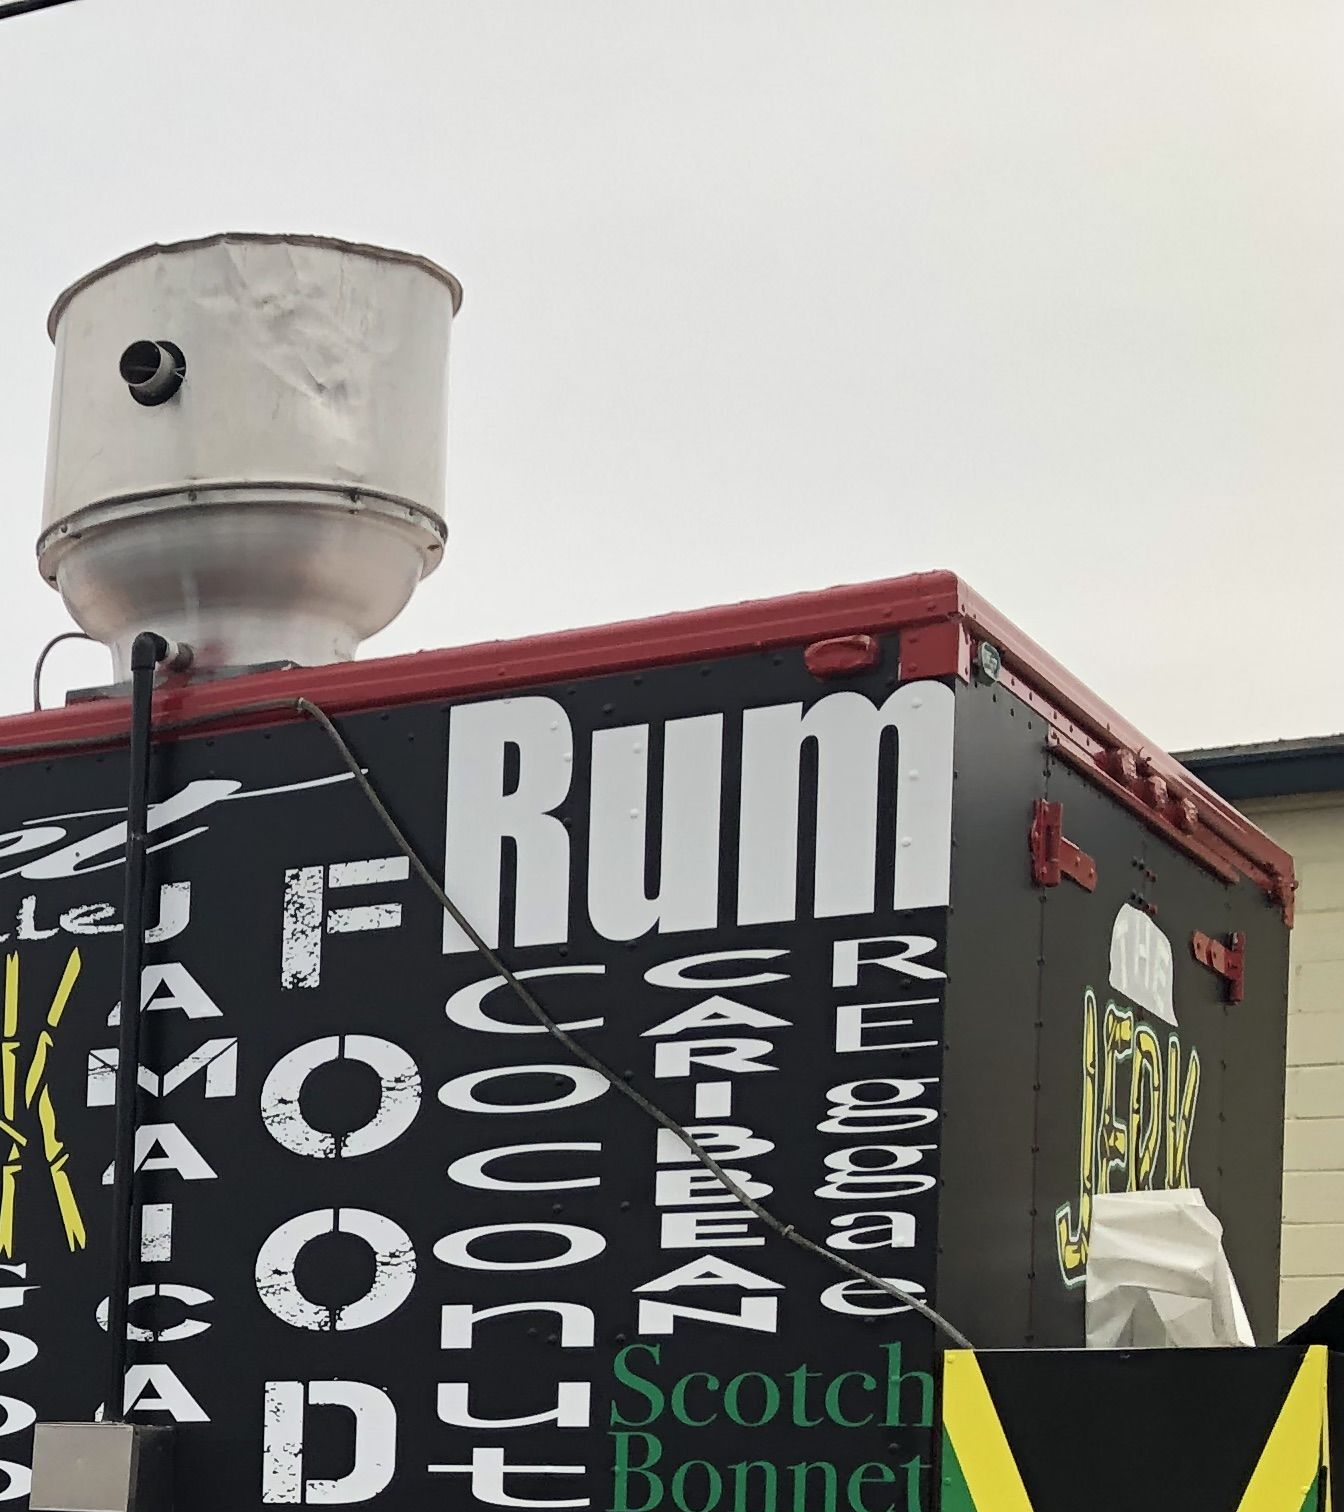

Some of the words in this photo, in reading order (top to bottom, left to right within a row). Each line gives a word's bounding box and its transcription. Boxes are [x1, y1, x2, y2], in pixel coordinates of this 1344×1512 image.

[442, 679, 957, 954] Rum
[86, 881, 238, 1423] JAMAICA
[255, 856, 422, 1505] FOOD
[631, 949, 794, 1334] CARIBBEAN
[1055, 985, 1200, 1290] JERK
[611, 1341, 936, 1428] Scotch
